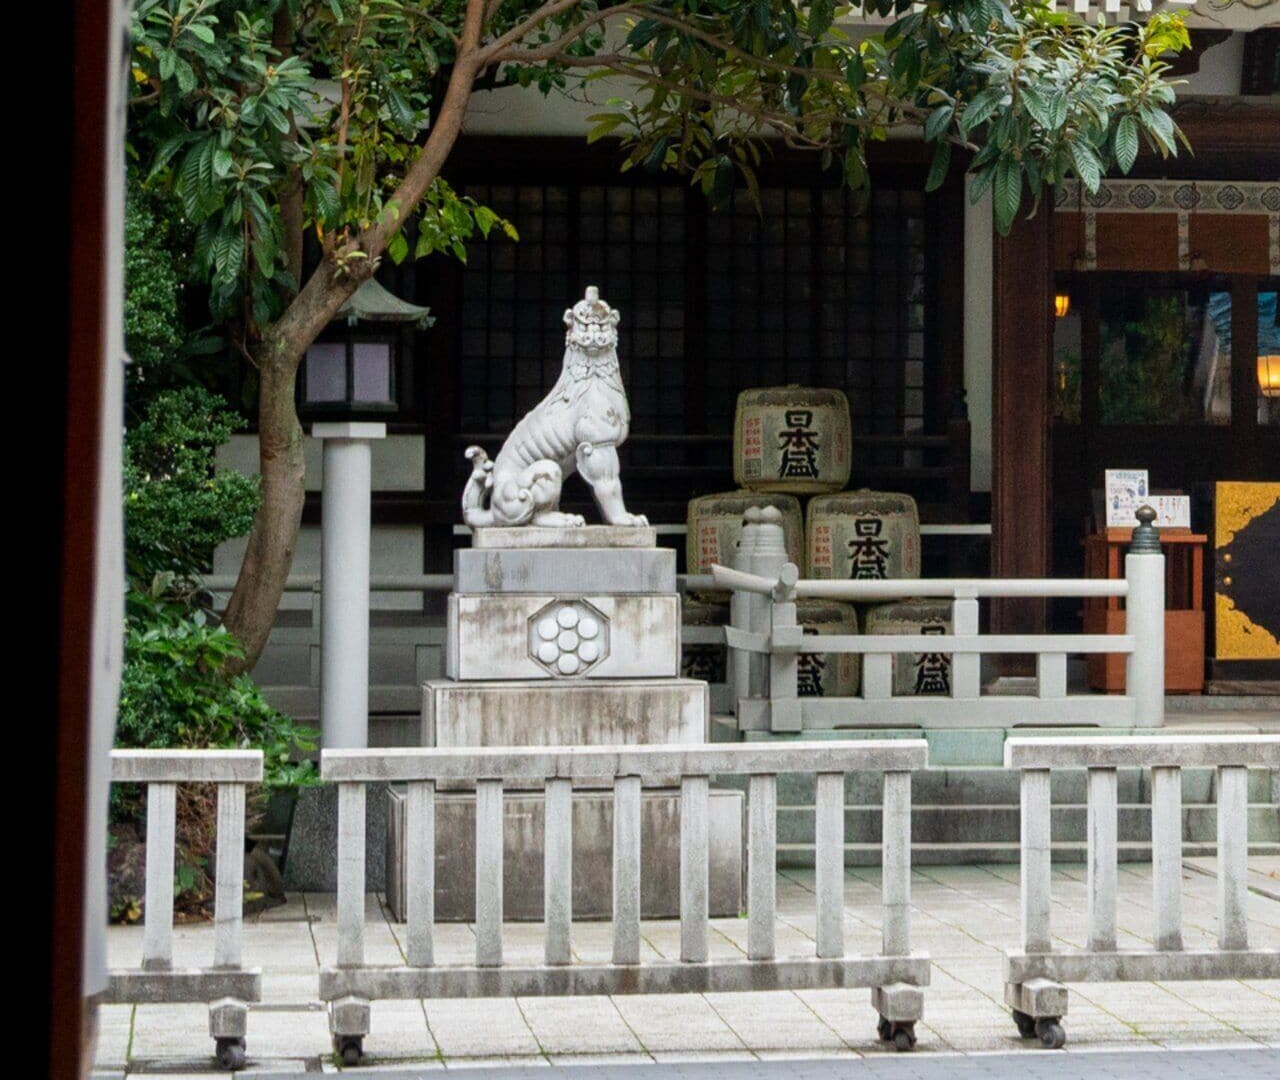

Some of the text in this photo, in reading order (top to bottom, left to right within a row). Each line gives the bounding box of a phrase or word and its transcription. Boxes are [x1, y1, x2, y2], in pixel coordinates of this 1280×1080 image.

[778, 410, 819, 478] 日本盛
[848, 519, 890, 579] 日本盛
